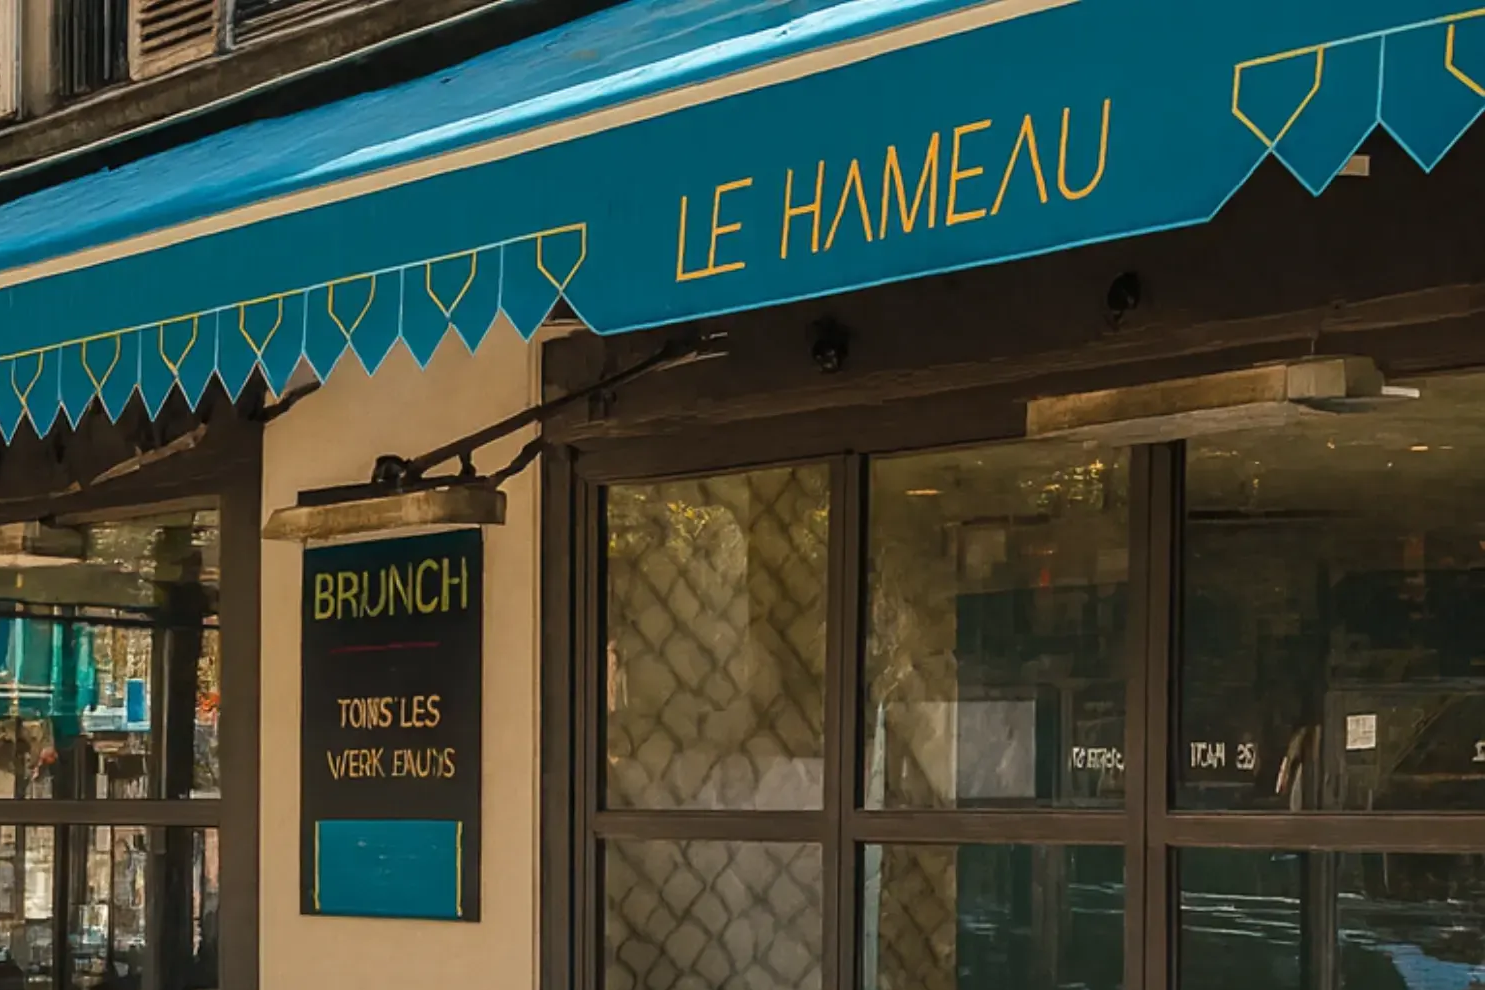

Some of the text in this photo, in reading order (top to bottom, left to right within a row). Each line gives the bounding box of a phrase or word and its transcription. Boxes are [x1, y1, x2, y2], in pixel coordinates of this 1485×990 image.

[675, 97, 1111, 282] LE HAMEAU
[314, 556, 468, 620] BRUNCH
[400, 694, 441, 728] LES
